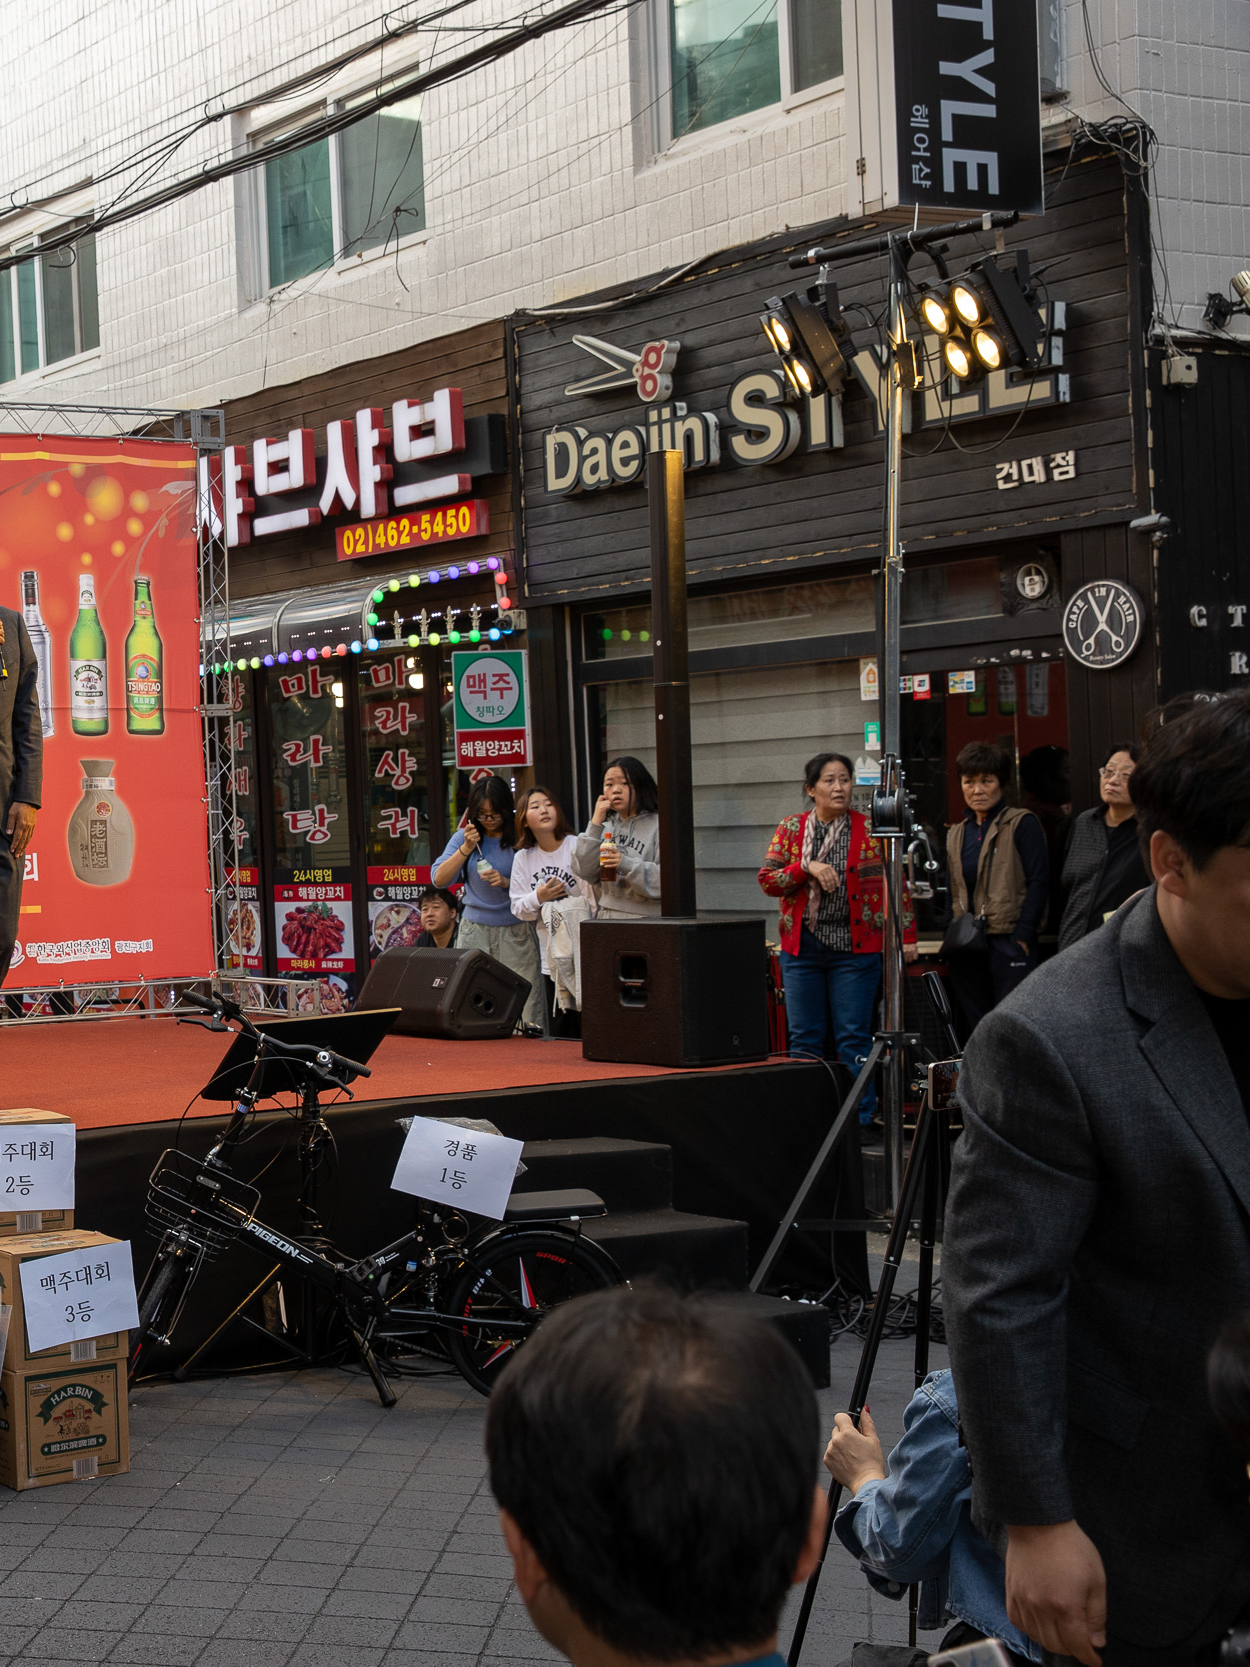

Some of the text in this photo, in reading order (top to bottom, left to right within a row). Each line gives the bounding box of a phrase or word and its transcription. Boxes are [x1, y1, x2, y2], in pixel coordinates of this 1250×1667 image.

[910, 104, 932, 189] 헤어샵
[196, 387, 472, 548] 샤브샤브
[342, 505, 472, 555] 02)462-5450
[1068, 586, 1135, 629] CAFE IN HAIR
[127, 681, 161, 692] TSINGTAO
[466, 672, 513, 701] 맥주
[475, 705, 506, 718] 칭따오
[278, 664, 339, 844] 마라탕
[369, 654, 418, 839] 마라샹궈
[460, 739, 525, 758] 해월양꼬치
[604, 834, 646, 856] AWAII
[293, 868, 333, 883] 24시영업
[383, 867, 417, 882] 24시영업
[298, 885, 345, 900] 해월양꼬치
[37, 938, 111, 956] 한국외식업중앙회
[115, 940, 153, 953] 광진구지회
[443, 1139, 478, 1162] 경품
[4, 1173, 35, 1197] 2등
[439, 1167, 468, 1190] 1등
[246, 1221, 301, 1259] PIGEON
[39, 1261, 112, 1295] 맥주대회
[64, 1301, 95, 1325] 3등
[50, 1386, 94, 1405] HARBIN
